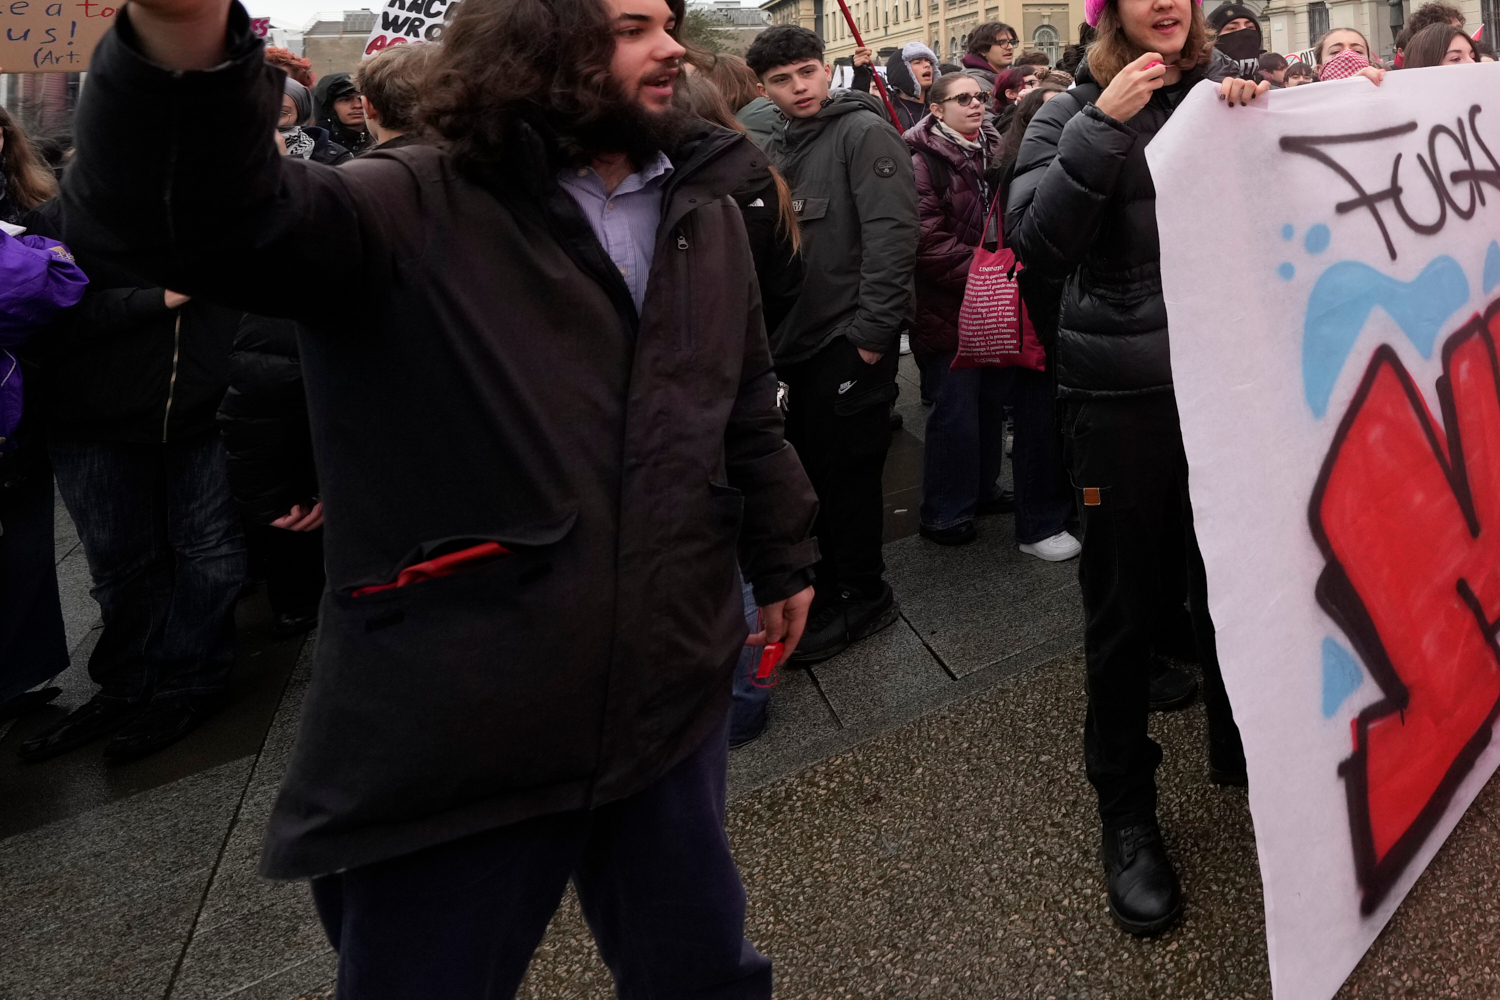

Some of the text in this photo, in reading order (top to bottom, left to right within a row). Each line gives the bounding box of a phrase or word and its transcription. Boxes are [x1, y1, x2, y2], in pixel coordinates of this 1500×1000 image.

[45, 3, 62, 17] a
[7, 20, 76, 45] us!
[381, 11, 446, 42] WRO
